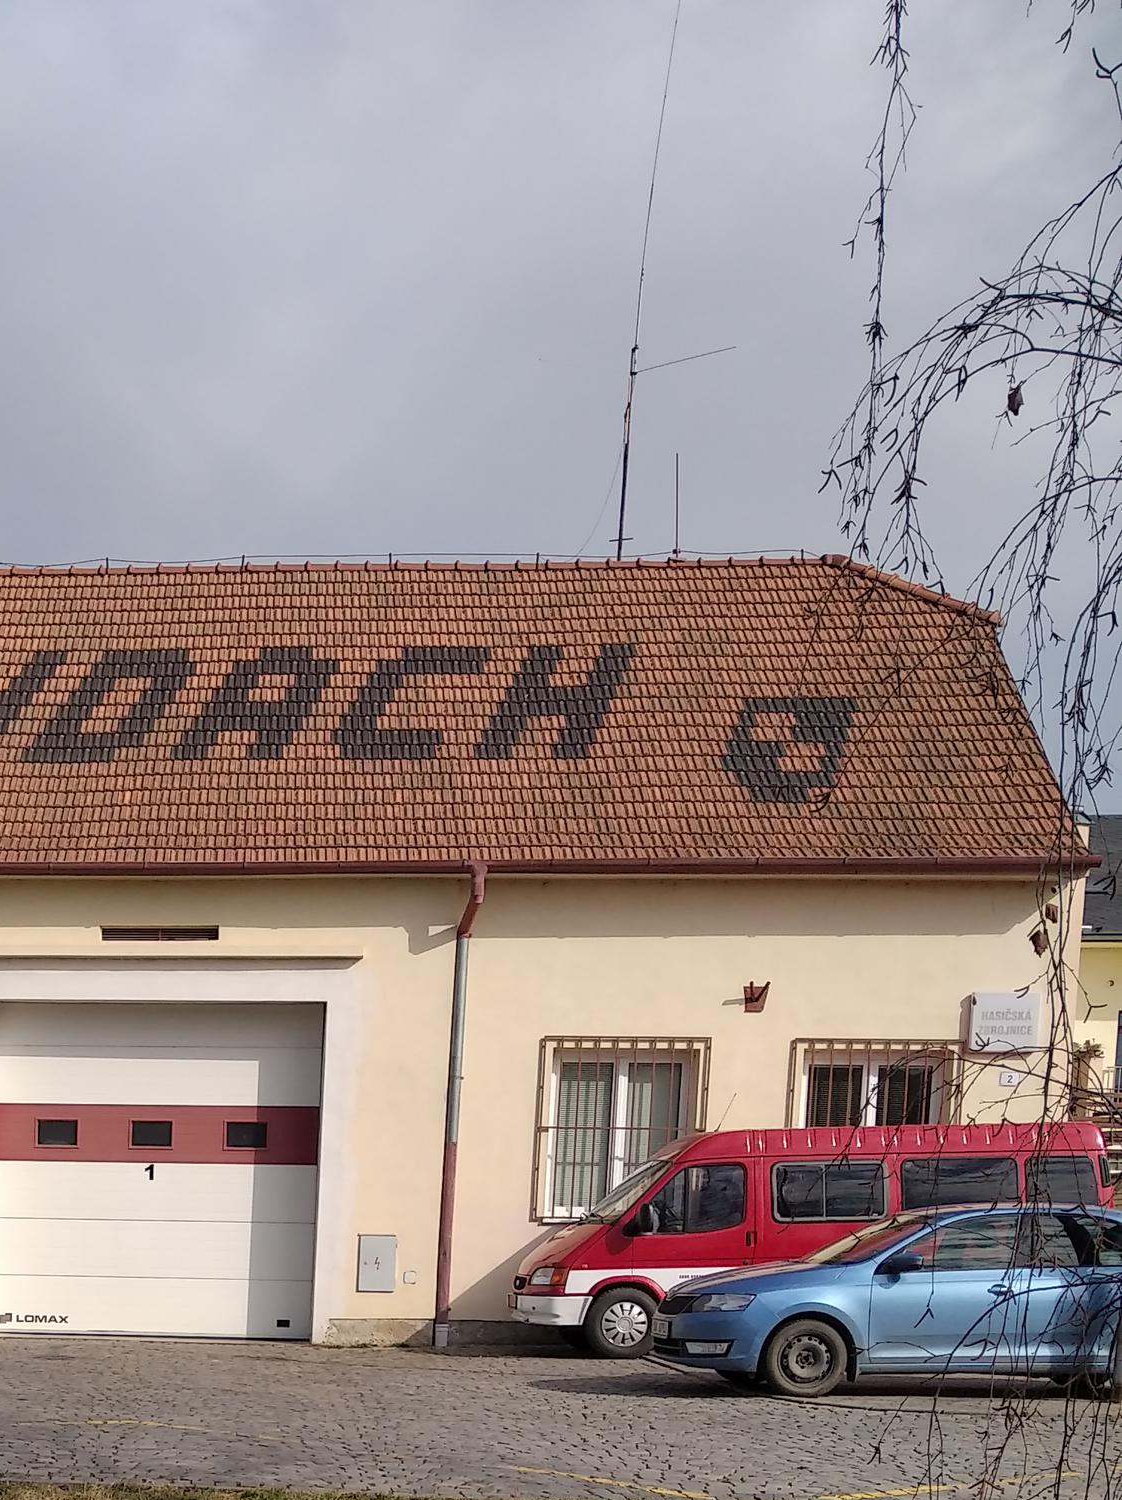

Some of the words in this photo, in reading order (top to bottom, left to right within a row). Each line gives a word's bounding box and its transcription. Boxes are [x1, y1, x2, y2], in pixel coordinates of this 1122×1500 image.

[1007, 1075, 1014, 1083] 2
[144, 1164, 155, 1181] 1
[16, 1315, 69, 1323] LOMAX
